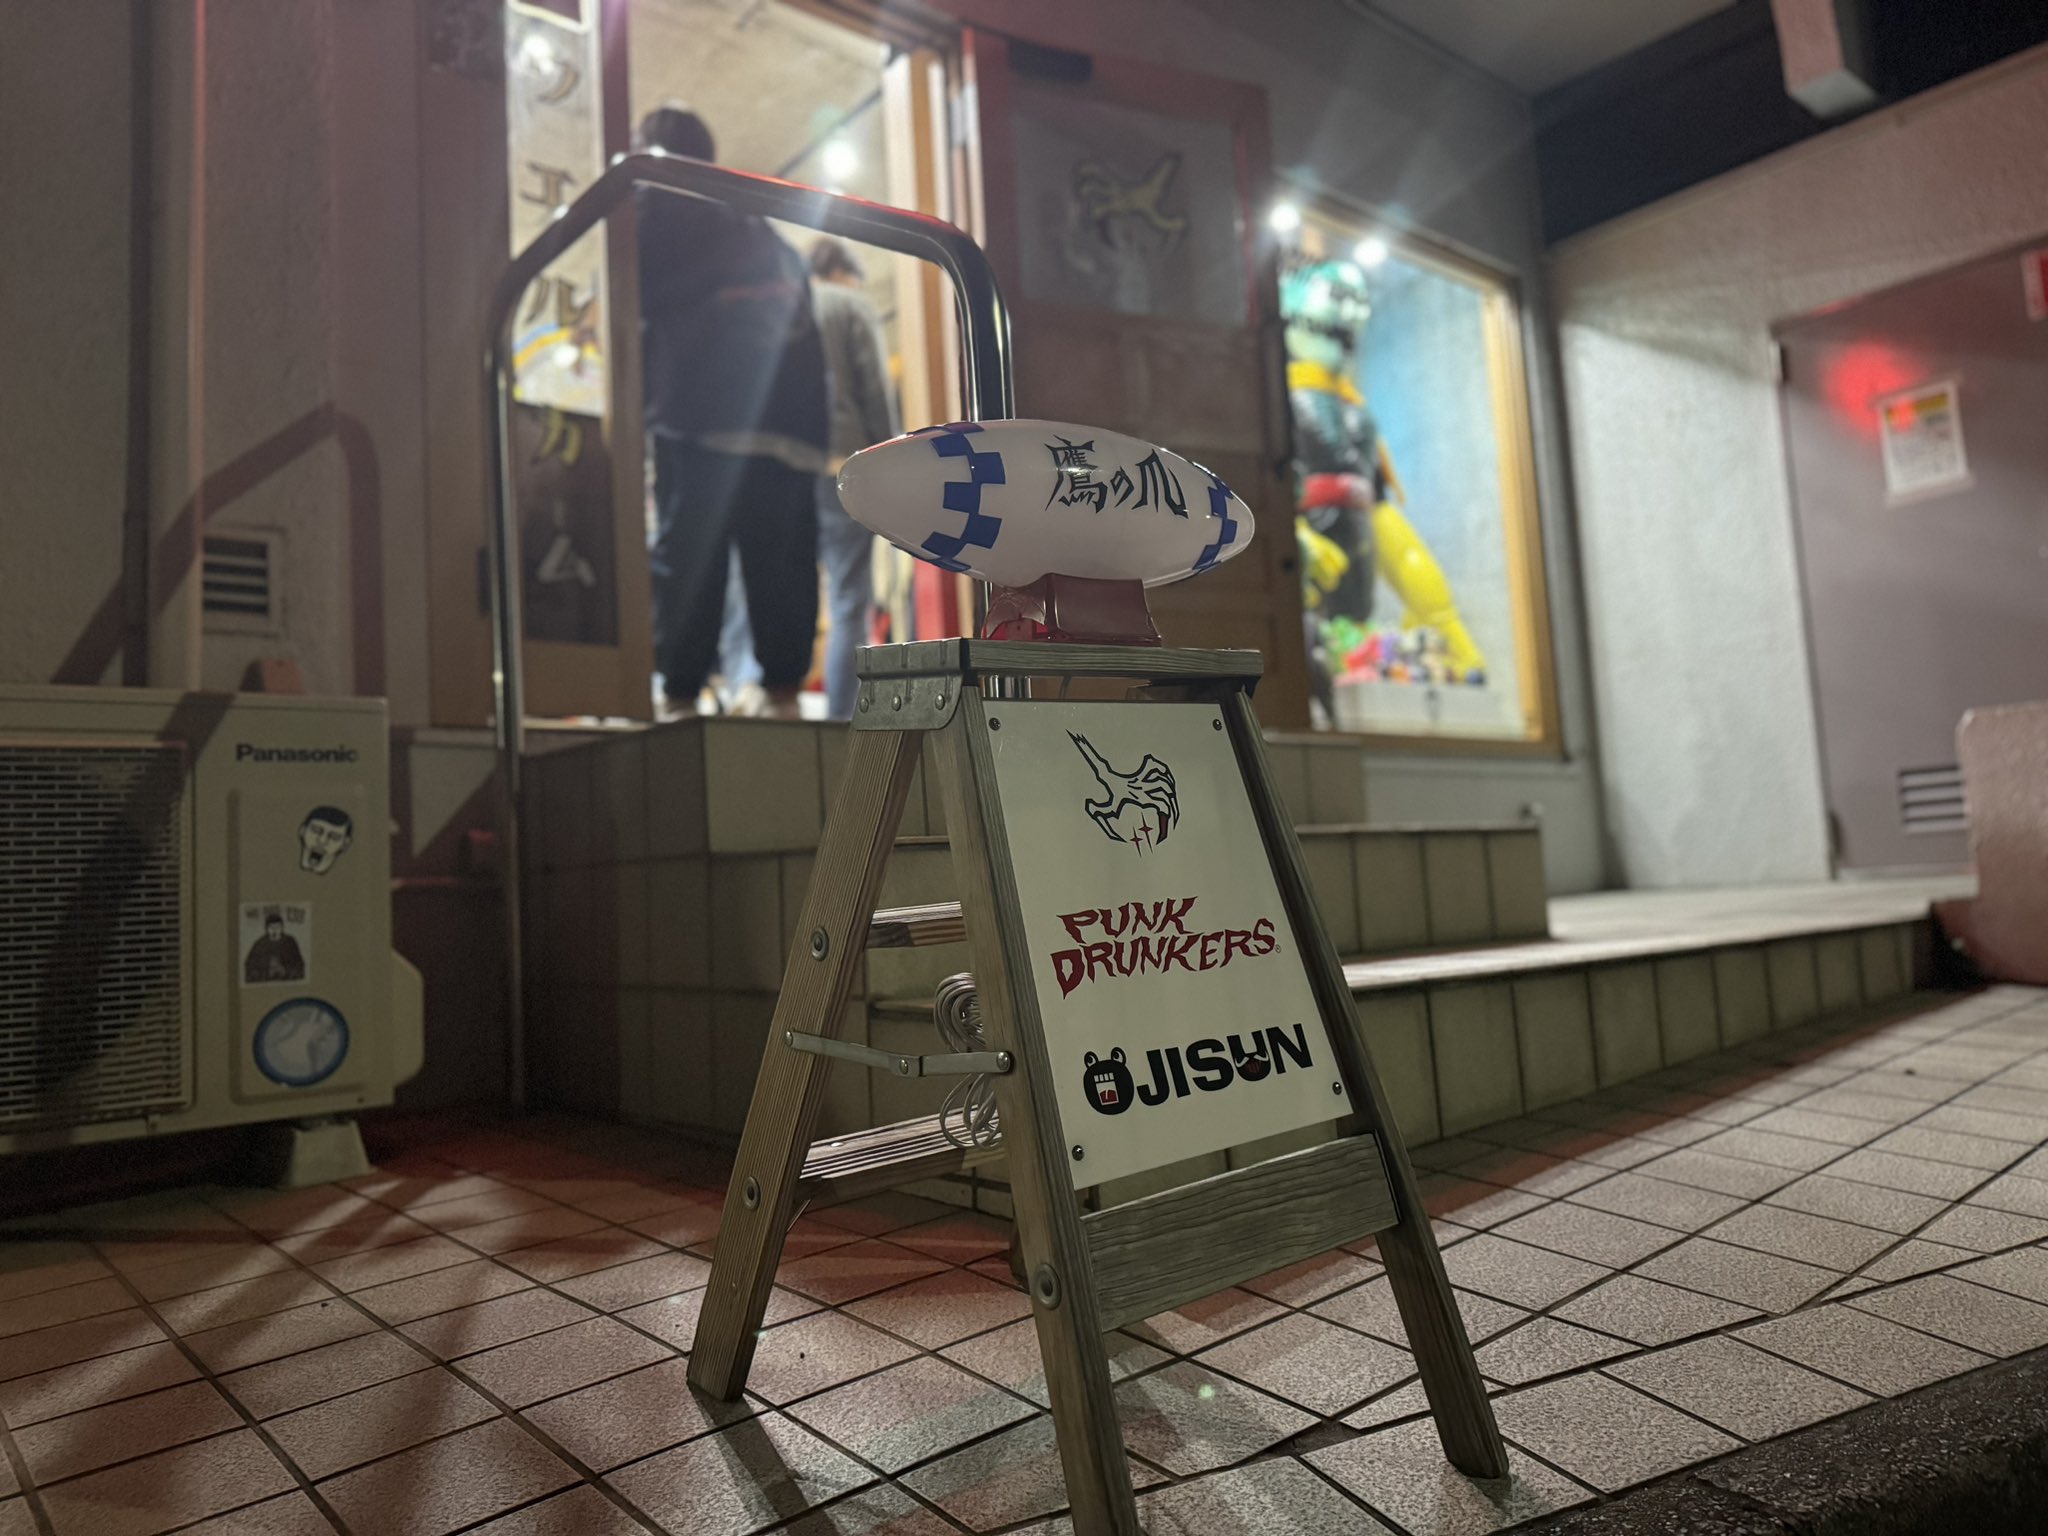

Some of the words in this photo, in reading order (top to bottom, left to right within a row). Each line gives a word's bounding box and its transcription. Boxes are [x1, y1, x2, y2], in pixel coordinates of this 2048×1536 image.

[1043, 434, 1189, 519] 鷹の爪
[235, 743, 358, 762] Panasonic
[1056, 896, 1197, 943] PUNK
[1050, 918, 1275, 999] DRUNKERS
